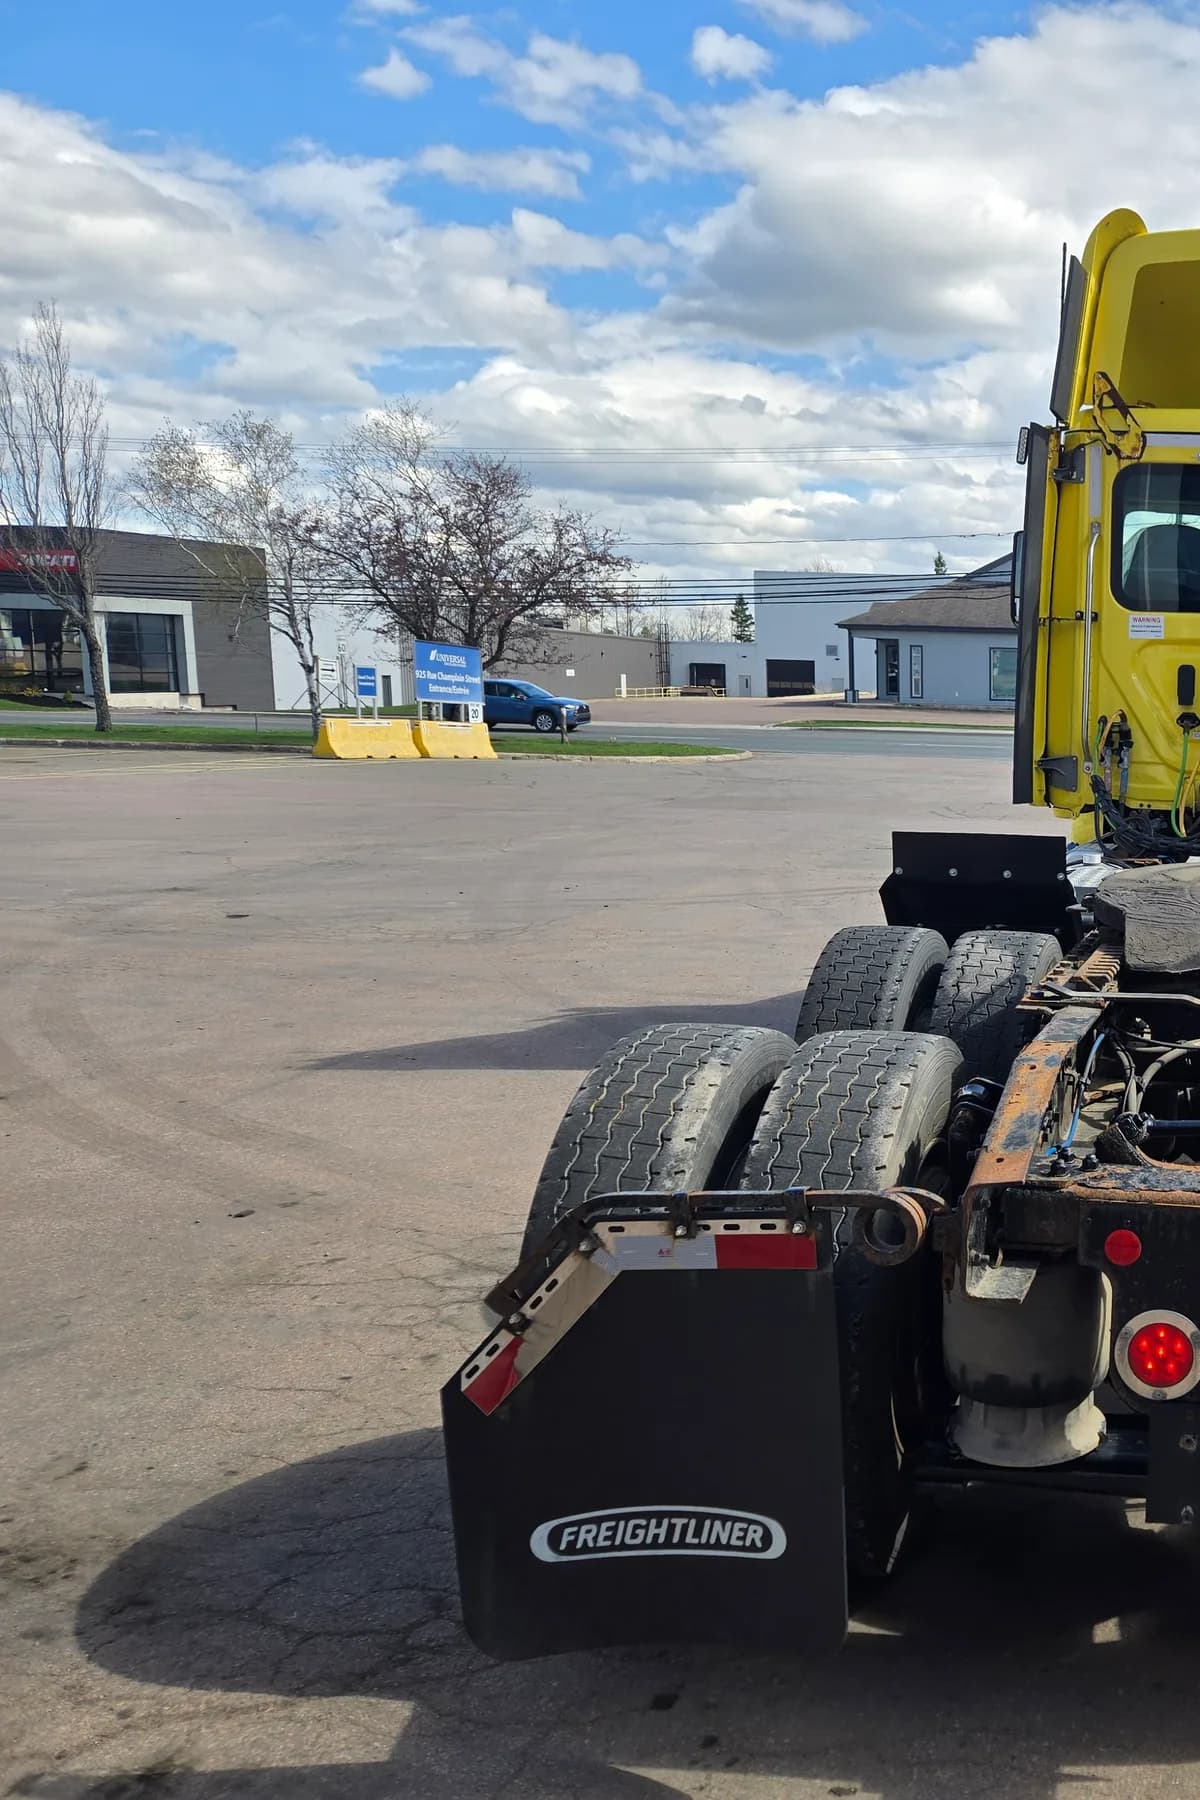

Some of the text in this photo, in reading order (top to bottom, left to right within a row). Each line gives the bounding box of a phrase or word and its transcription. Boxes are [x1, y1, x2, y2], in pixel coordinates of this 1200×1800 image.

[1132, 616, 1161, 624] WARNING
[436, 652, 467, 665] UNIVERSAL
[415, 669, 481, 685] 925 Rue Champlain Street
[471, 708, 479, 719] 20
[559, 1516, 764, 1551] FREIGHTLINER
